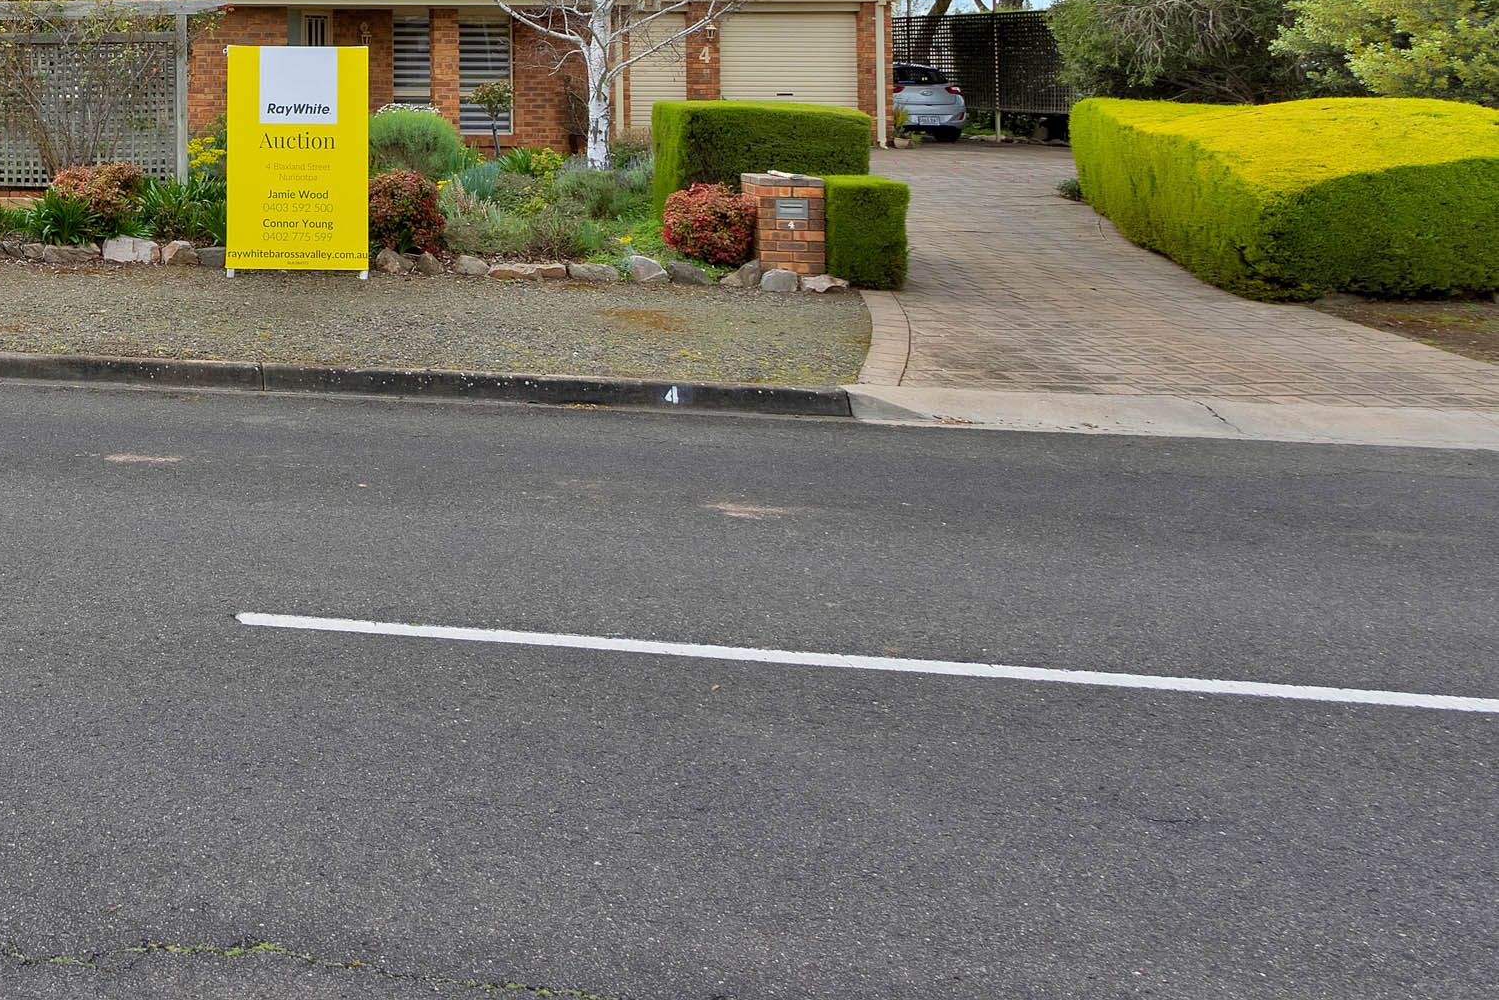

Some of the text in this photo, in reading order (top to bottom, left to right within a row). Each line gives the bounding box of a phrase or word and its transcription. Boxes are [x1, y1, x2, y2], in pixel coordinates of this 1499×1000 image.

[699, 46, 711, 63] 4
[259, 131, 335, 150] Auction
[267, 189, 329, 199] Jamie Wood
[262, 203, 334, 213] 0403 592 500
[262, 218, 334, 231] Connor Young
[788, 221, 795, 230] 4
[262, 232, 333, 242] 0402 775 599
[227, 249, 368, 261] raywhitebarossavalley.com.au
[664, 385, 679, 404] 4
